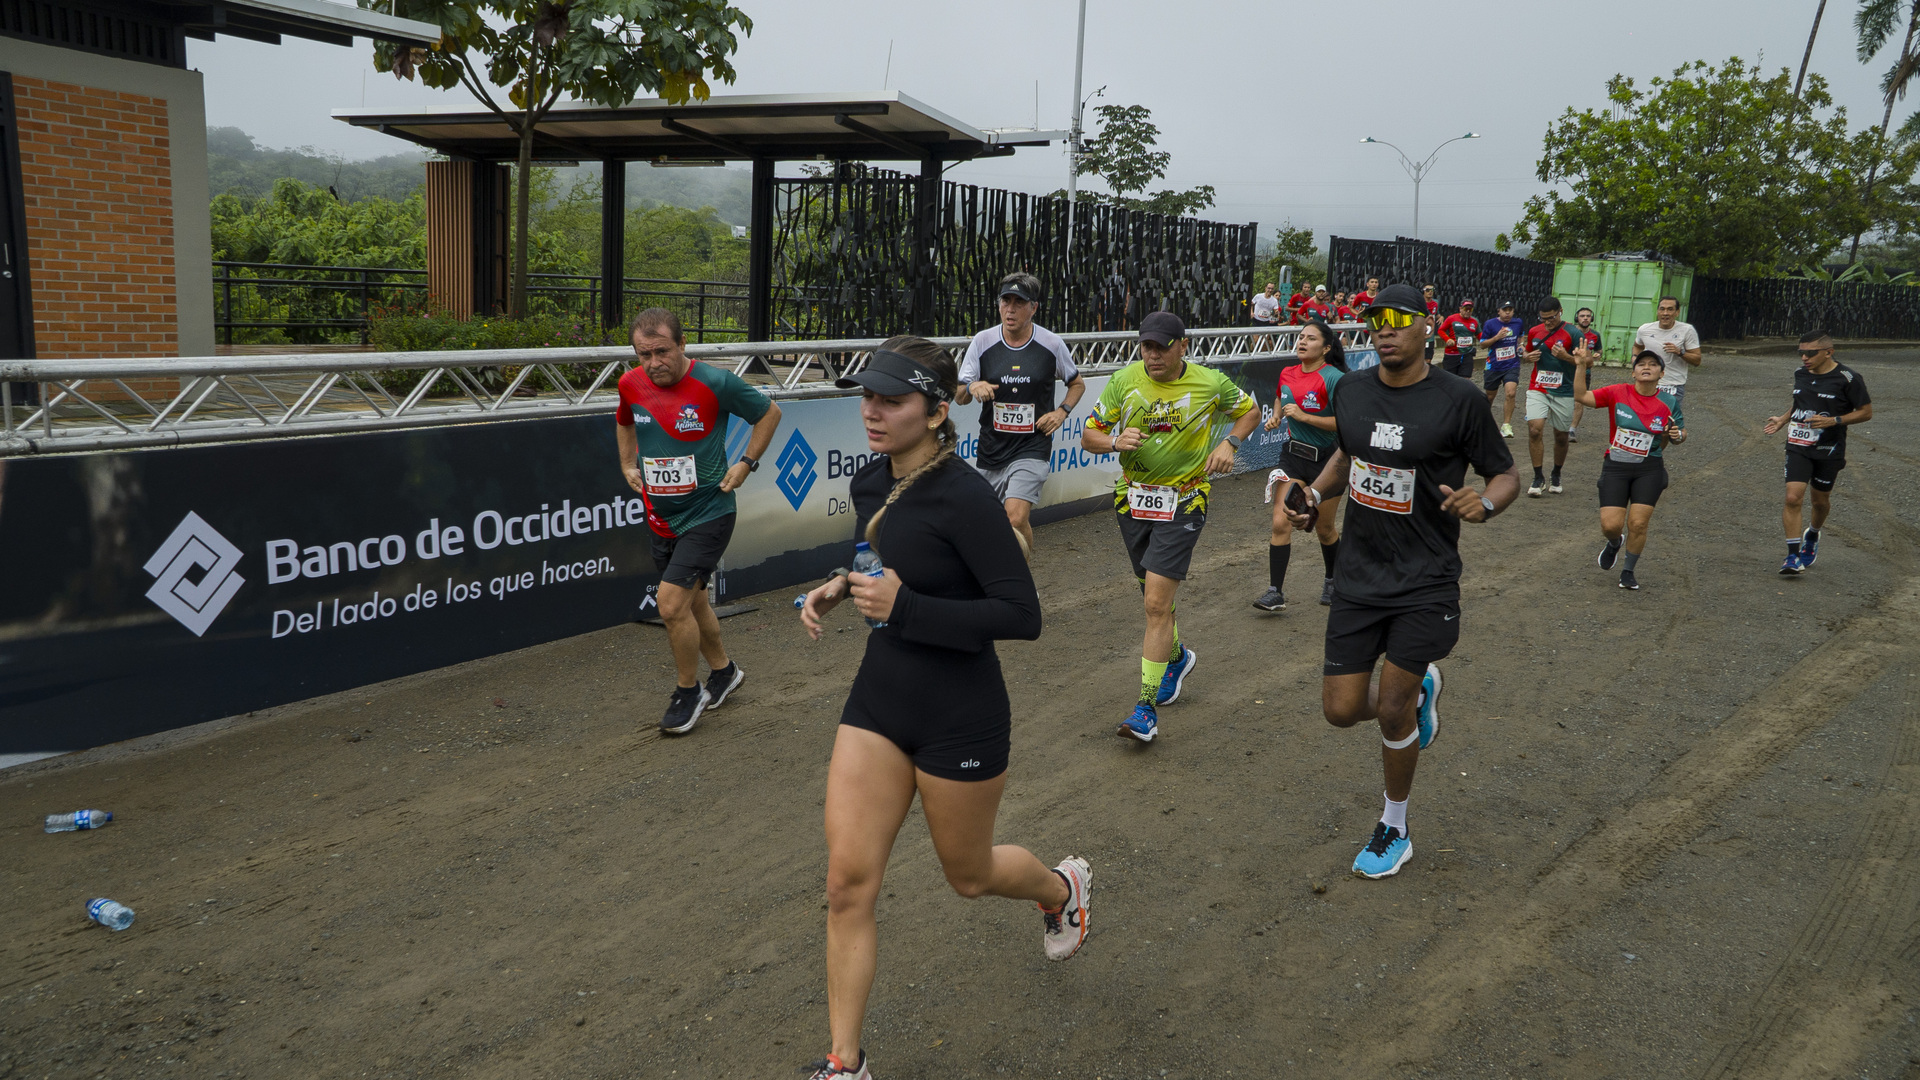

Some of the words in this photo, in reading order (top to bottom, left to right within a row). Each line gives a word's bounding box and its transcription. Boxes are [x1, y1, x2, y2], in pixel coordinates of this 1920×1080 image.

[1000, 375, 1031, 384] Warriors
[1540, 375, 1558, 384] 2099
[1002, 412, 1024, 424] 579
[1792, 429, 1810, 440] 580
[1623, 436, 1642, 448] 717
[652, 470, 681, 484] 703
[1361, 477, 1395, 498] 454
[828, 493, 852, 516] Del
[1135, 495, 1163, 509] 786
[266, 535, 406, 585] Banco
[416, 518, 465, 560] de
[473, 496, 645, 550] Occidente
[272, 601, 324, 639] Del
[332, 590, 397, 628] lado
[403, 582, 438, 612] de
[446, 577, 482, 604] los
[490, 571, 535, 605] que
[541, 557, 615, 586] hacen.
[960, 758, 980, 768] alo
